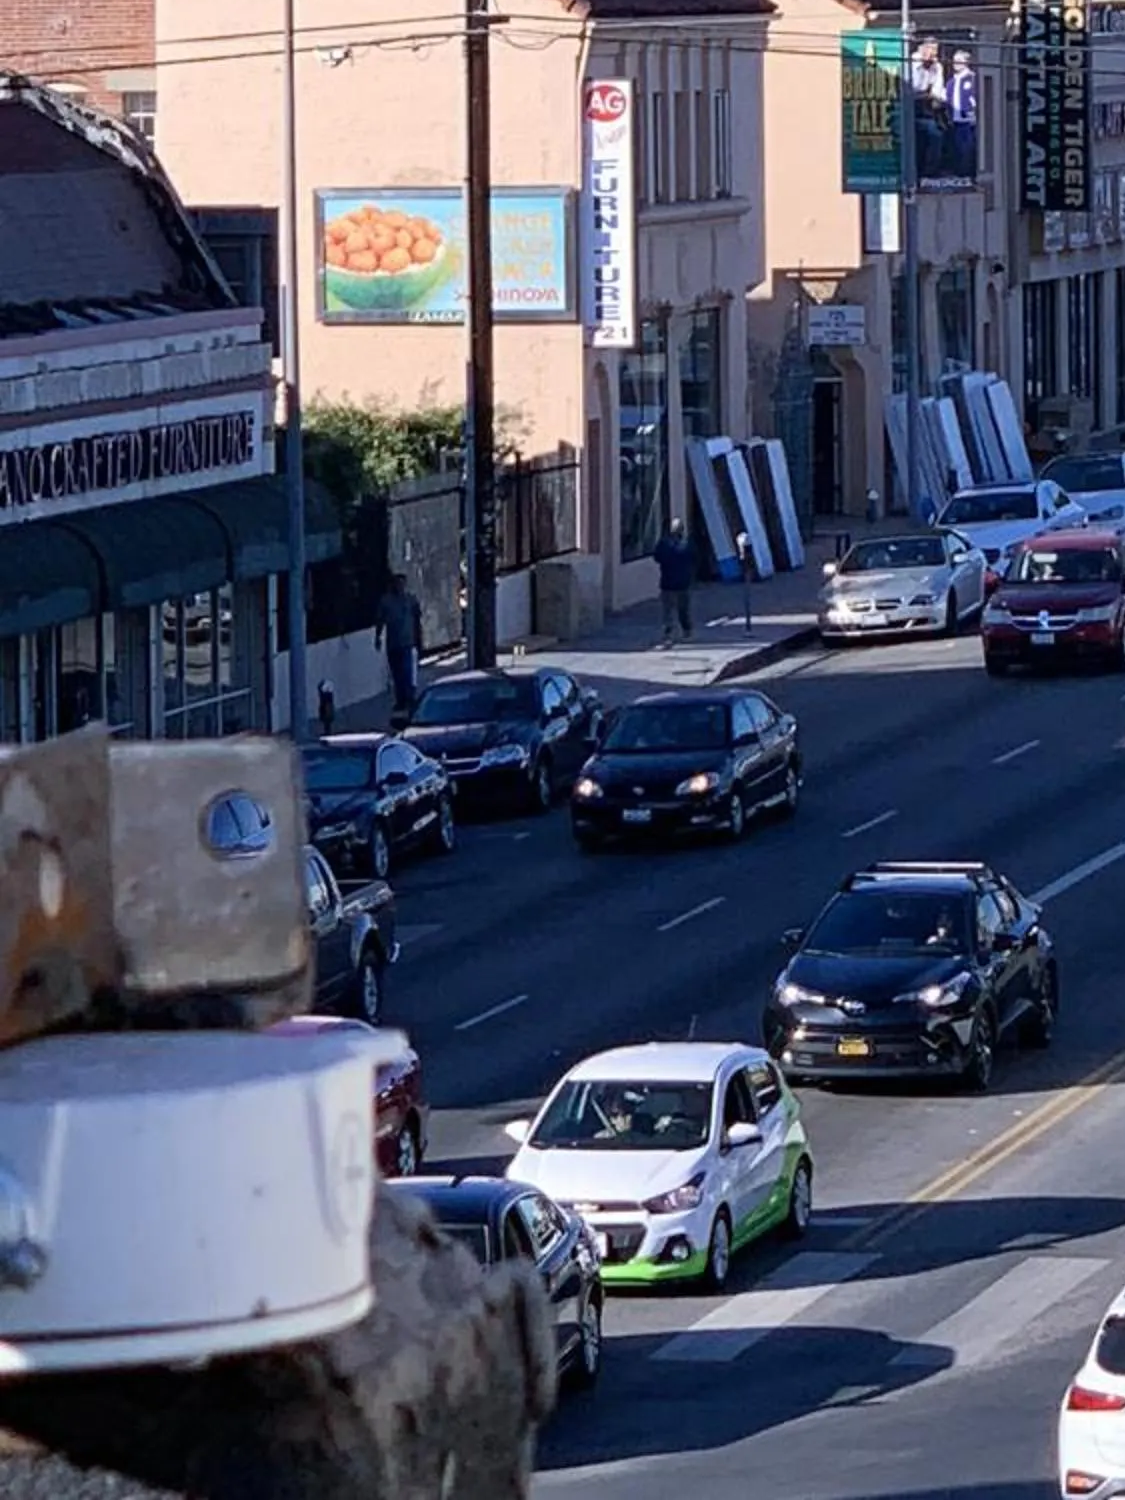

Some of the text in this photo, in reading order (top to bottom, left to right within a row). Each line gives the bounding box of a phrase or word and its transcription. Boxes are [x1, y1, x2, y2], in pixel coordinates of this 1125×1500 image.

[590, 90, 626, 110] AG
[851, 100, 892, 133] TALE
[1026, 139, 1046, 207] ART
[1063, 118, 1085, 206] TIGER
[592, 159, 621, 321] FURNITURE
[149, 412, 254, 480] FURNITURE
